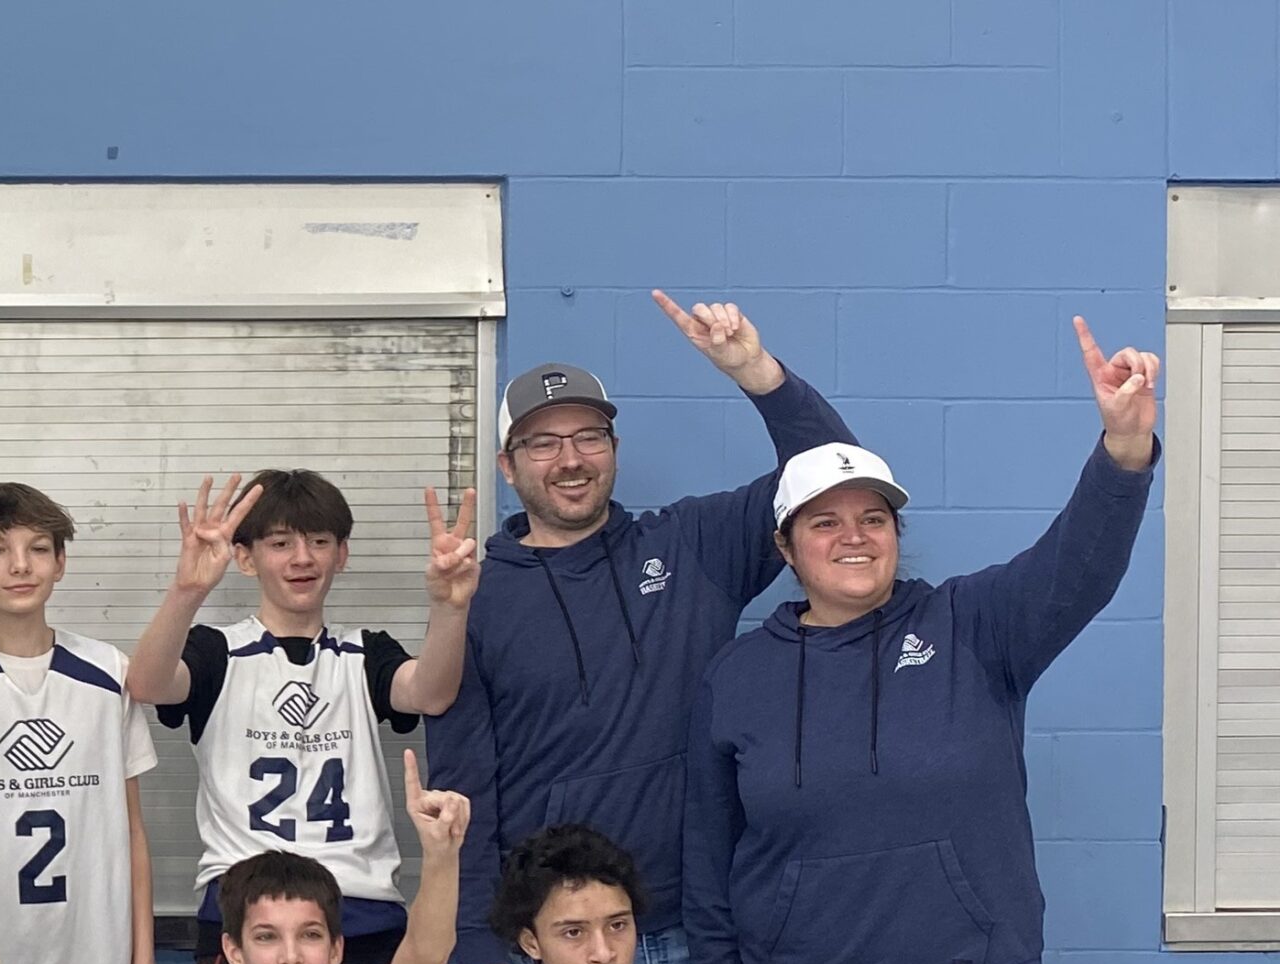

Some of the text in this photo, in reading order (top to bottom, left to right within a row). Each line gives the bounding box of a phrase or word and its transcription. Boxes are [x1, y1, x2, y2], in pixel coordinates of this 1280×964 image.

[246, 728, 277, 740] BOYS
[280, 731, 290, 740] &
[266, 741, 277, 750] OF
[9, 779, 21, 790] &
[24, 776, 65, 789] GIRLS
[68, 774, 100, 787] CLUB
[18, 789, 70, 799] MANCHESTER
[248, 756, 354, 843] 24
[15, 809, 67, 905] 2
